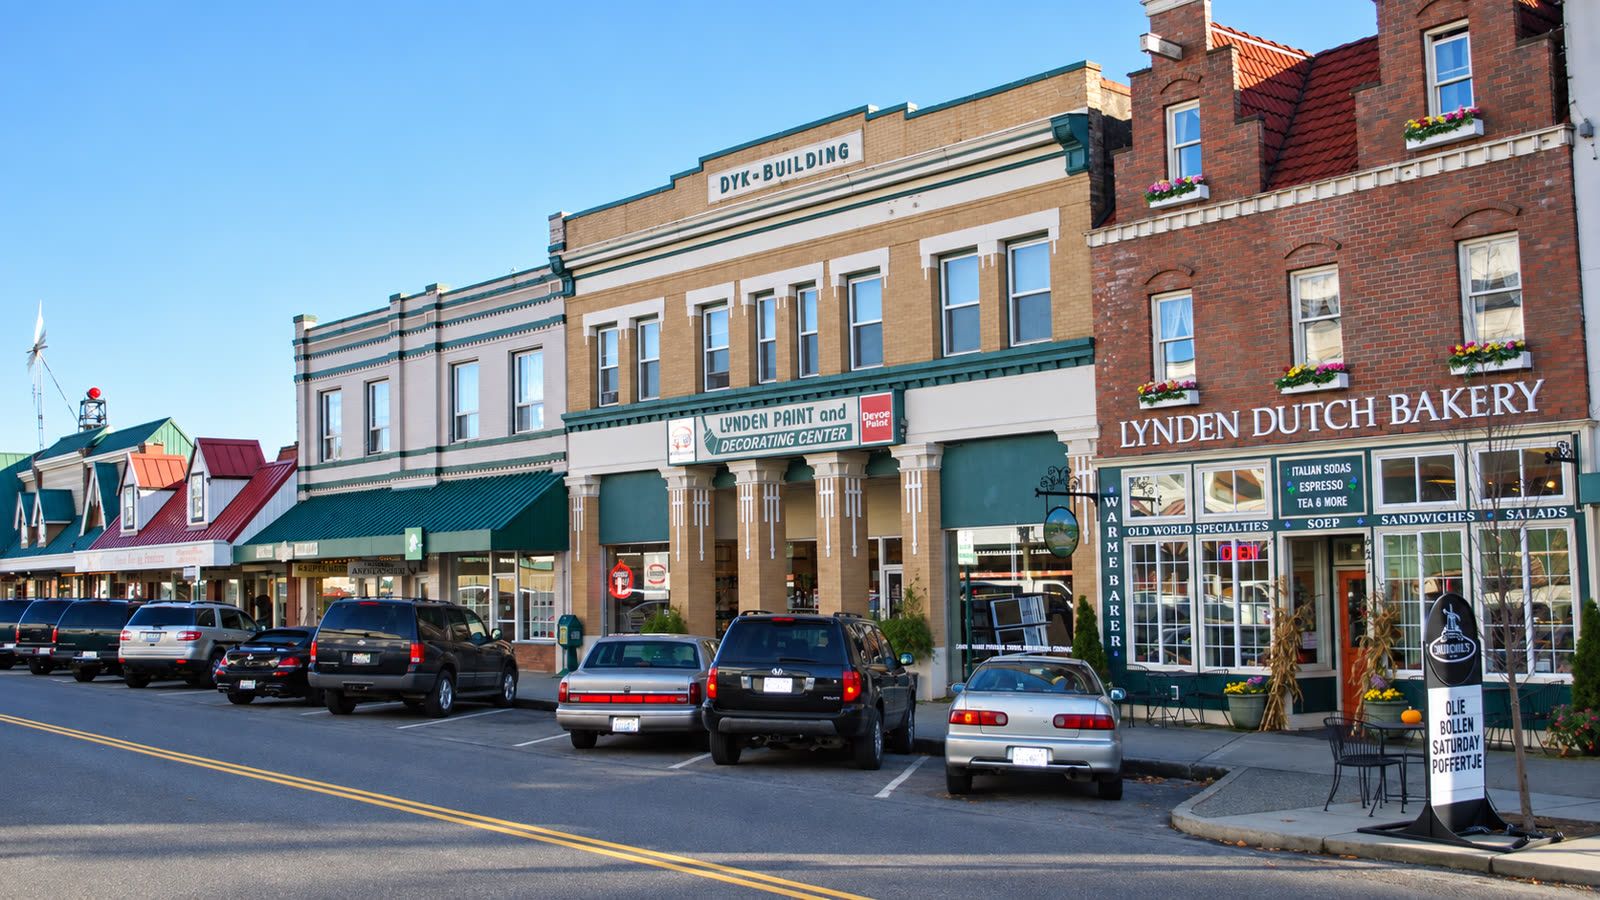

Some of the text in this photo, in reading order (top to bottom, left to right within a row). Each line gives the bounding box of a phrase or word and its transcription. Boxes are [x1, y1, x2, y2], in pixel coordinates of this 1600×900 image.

[719, 403, 846, 433] LYNDEN PAINT and
[862, 411, 890, 421] Devoe
[1120, 379, 1544, 448] LYNDEN DUTCH BAKERY
[866, 419, 889, 428] Paint
[721, 427, 847, 453] DECORATING CENTER
[1291, 463, 1352, 477] ITALIAN SODAS
[1299, 480, 1344, 493] ESPRESSO
[1297, 496, 1348, 508] TEA & MORE
[1381, 511, 1476, 525] SANDWICHES
[1506, 507, 1568, 519] SALADS
[1128, 520, 1269, 536] OLD WORLD SPECIALTIES
[1307, 518, 1340, 529] SOEP
[1221, 544, 1259, 560] OEN
[1104, 496, 1122, 647] WARME BAKER
[1446, 699, 1466, 716] OLIE
[1440, 717, 1474, 735] BOLLEN
[1432, 735, 1480, 755] SATURDAY
[1432, 753, 1482, 774] POFFERTJE
